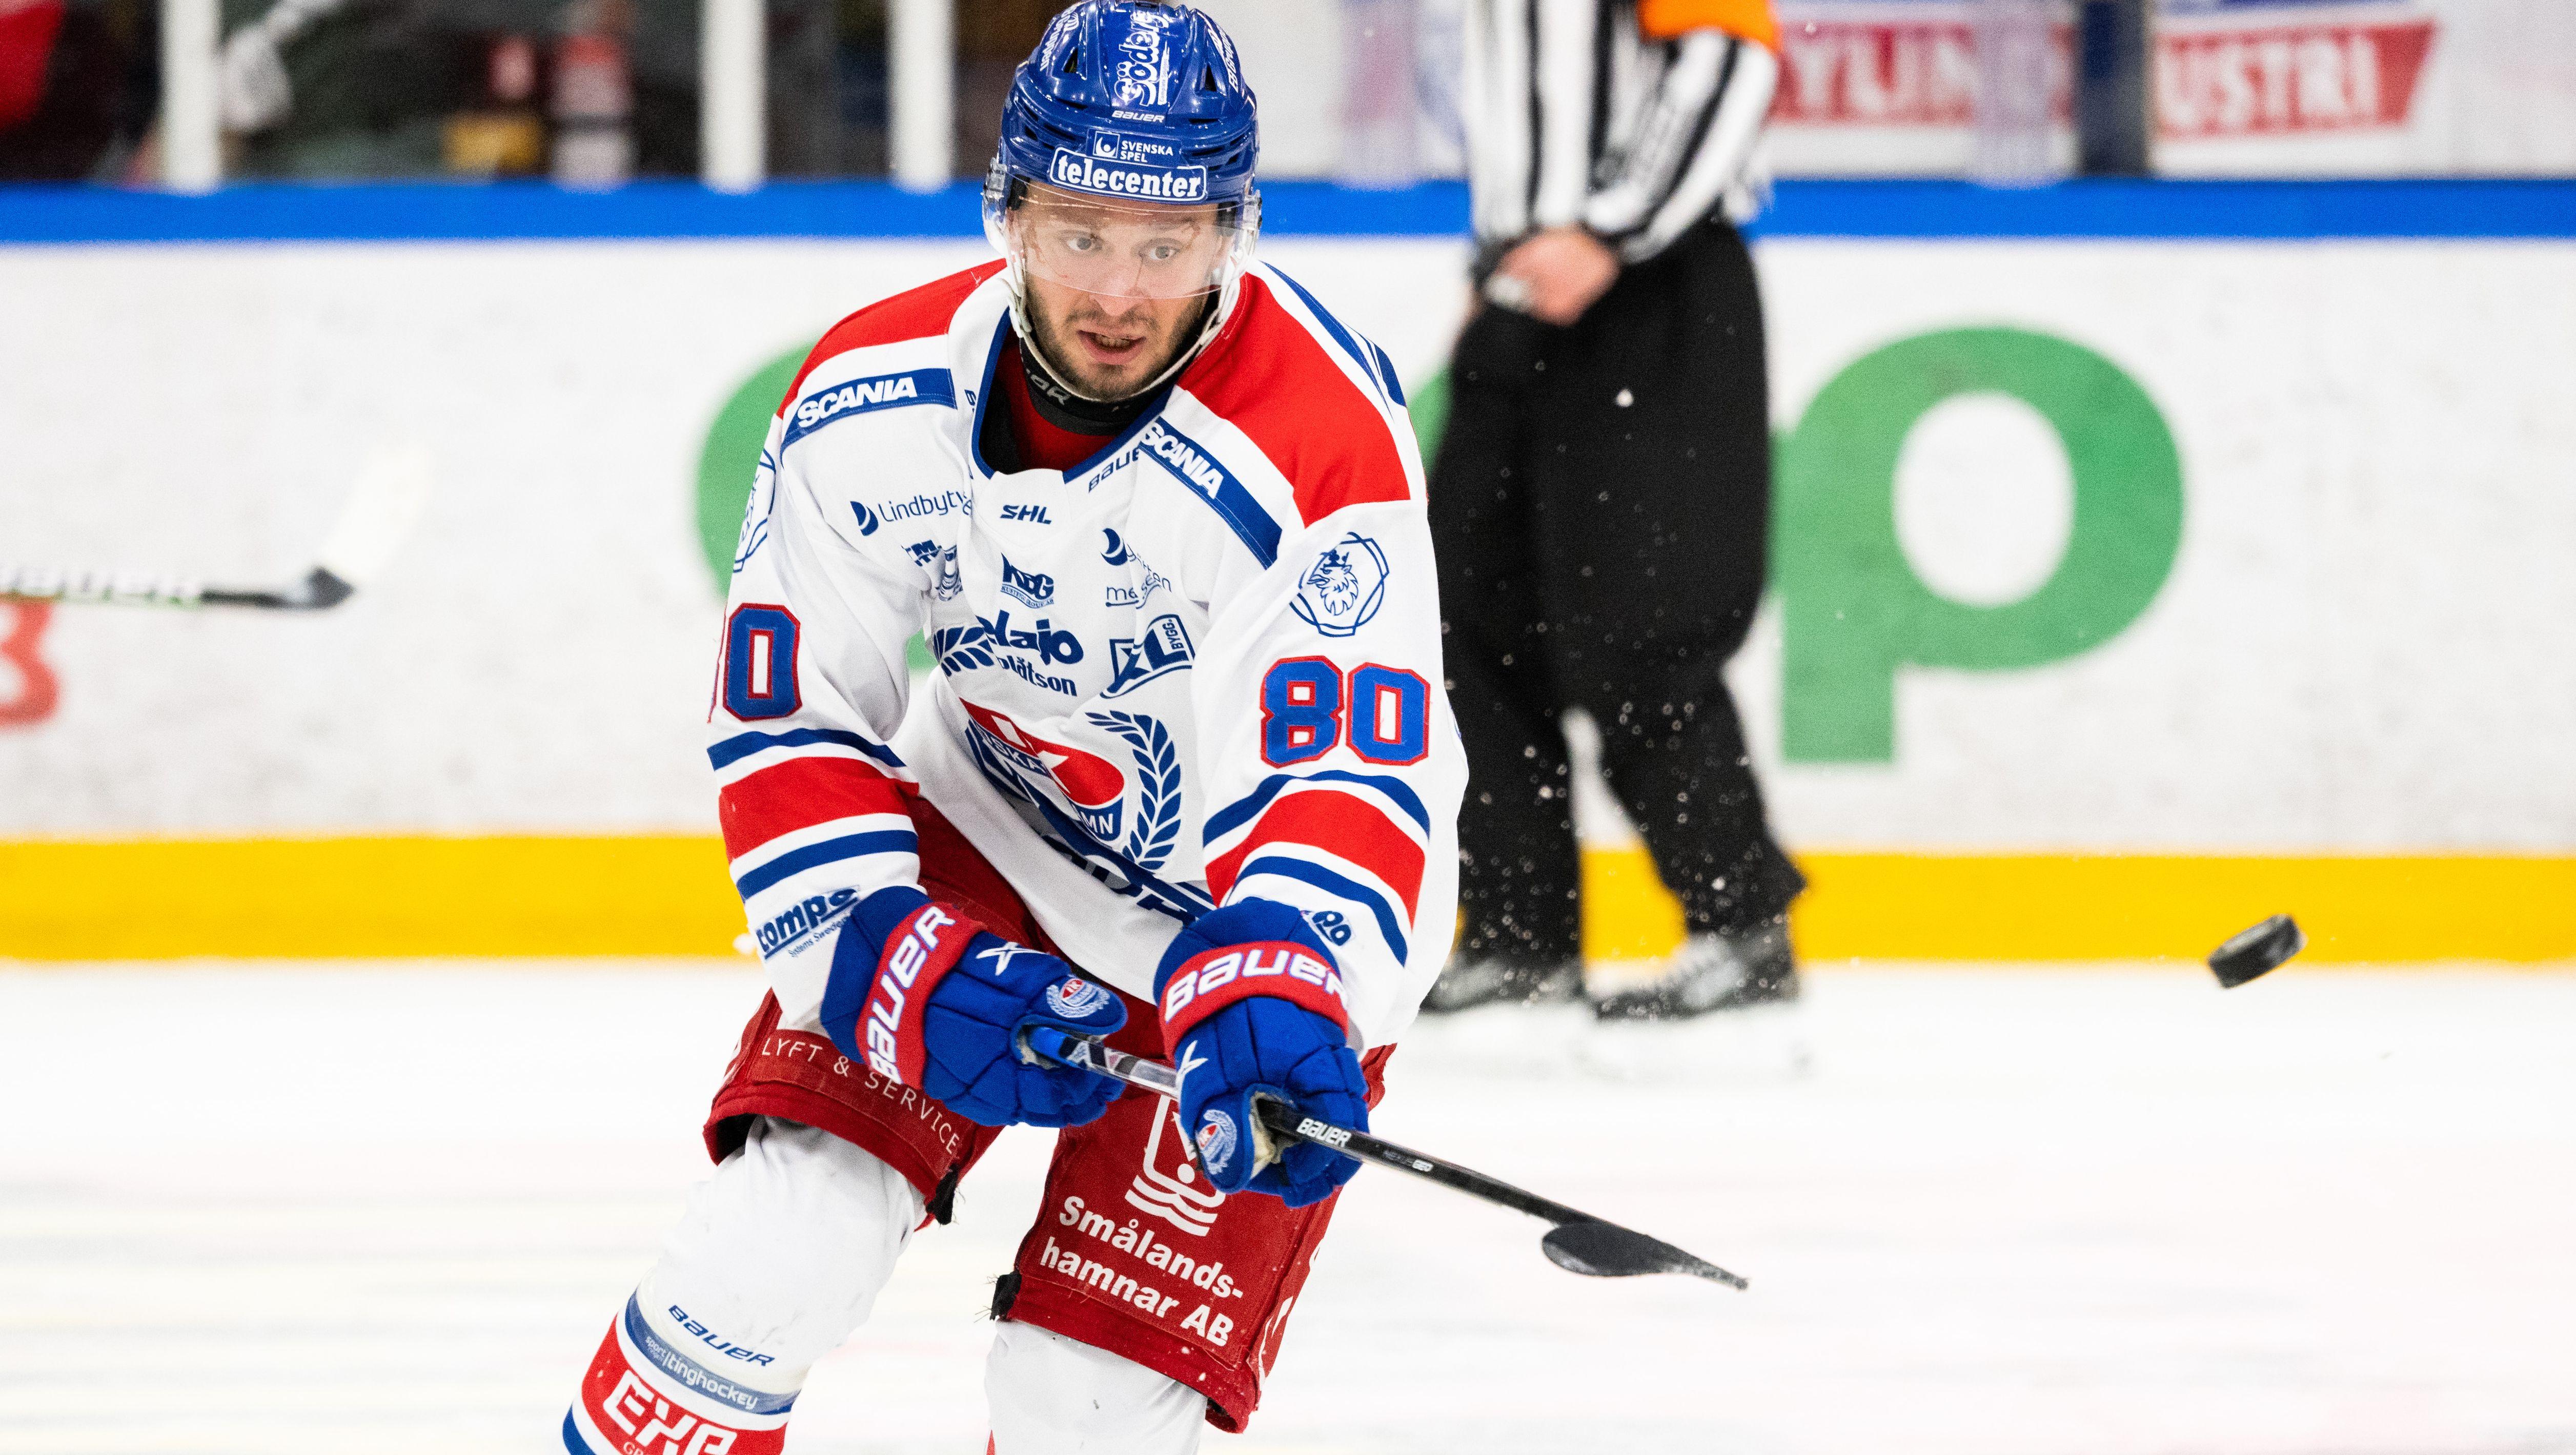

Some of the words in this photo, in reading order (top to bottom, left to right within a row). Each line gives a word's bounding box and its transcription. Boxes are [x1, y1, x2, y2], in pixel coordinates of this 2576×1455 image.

[1111, 110, 1165, 124] BAUER
[1120, 151, 1148, 163] SPEL
[1121, 140, 1173, 156] SVENSKA
[1058, 154, 1202, 198] telecenter
[797, 377, 918, 427] SCANIA
[1088, 448, 1141, 494] BAUE
[1141, 422, 1224, 500] SCANIA
[1000, 505, 1052, 526] SHL
[1260, 654, 1431, 769] 80
[866, 906, 956, 1085] BAUER
[762, 1037, 823, 1062] LYFT
[833, 1056, 850, 1078] &
[865, 1072, 960, 1155] SERVICE
[1296, 1118, 1352, 1149] BAUER
[1059, 1196, 1244, 1300] Smålands-
[1039, 1237, 1180, 1319] hamnar
[1180, 1305, 1234, 1347] AB
[668, 1305, 776, 1367] BAUER
